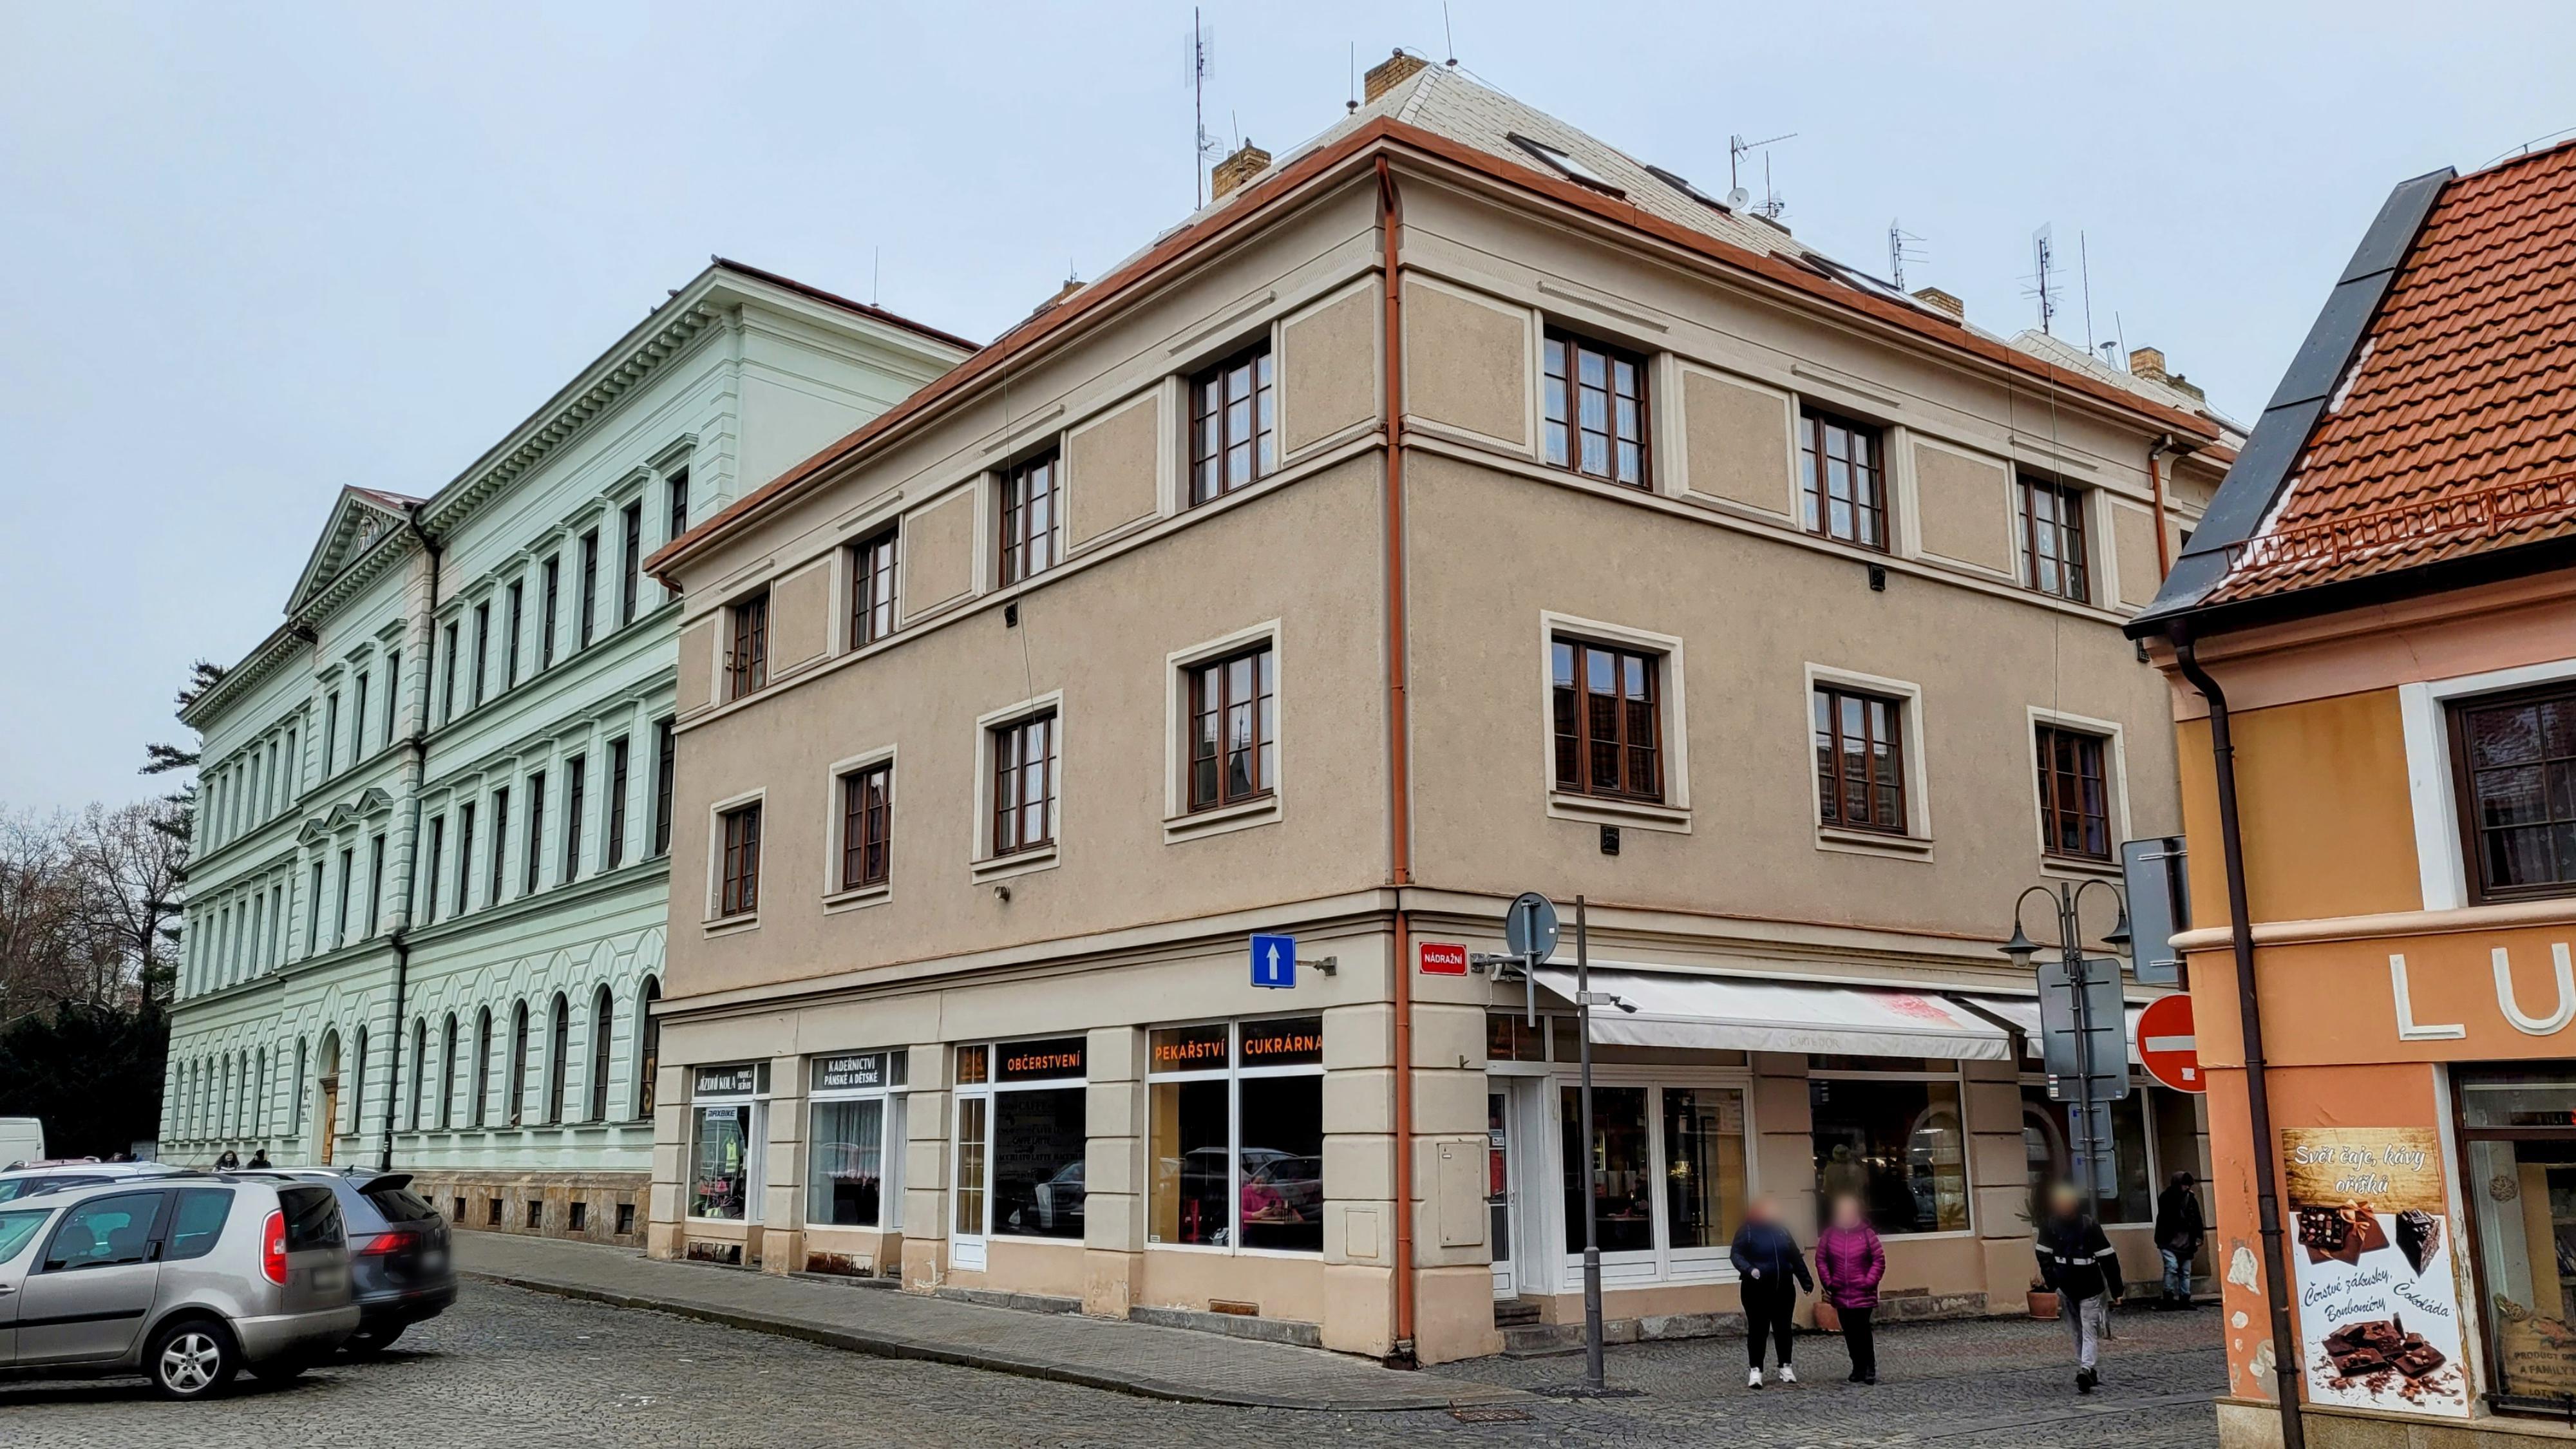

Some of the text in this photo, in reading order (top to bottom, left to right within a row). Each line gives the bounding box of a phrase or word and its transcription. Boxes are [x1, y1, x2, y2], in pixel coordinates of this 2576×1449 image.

[1425, 952, 1463, 965] NÁDRAŽNÍ
[1155, 1033, 1323, 1061] PEKAŘSTVÍ CUKRÁRNA
[828, 1055, 875, 1072] KADEŘNICTVÍ
[1008, 1050, 1080, 1070] OBČERSTVENÍ
[698, 1075, 735, 1091] JÍZDNÍ KOLA
[737, 1070, 752, 1079] PRODEJ
[824, 1070, 878, 1086] PÁNSKÉ A DĚTSKÉ
[2295, 1144, 2426, 1172] Svět čaje, kávy
[2336, 1173, 2389, 1195] oříšků
[2304, 1275, 2342, 1307] Čerstvé
[2393, 1278, 2449, 1317] Čokoláda
[2325, 1296, 2385, 1322] Bonboniéry
[2514, 1352, 2558, 1360] PRODUCT
[2521, 1365, 2526, 1374] A
[2530, 1365, 2567, 1375] FAMILY
